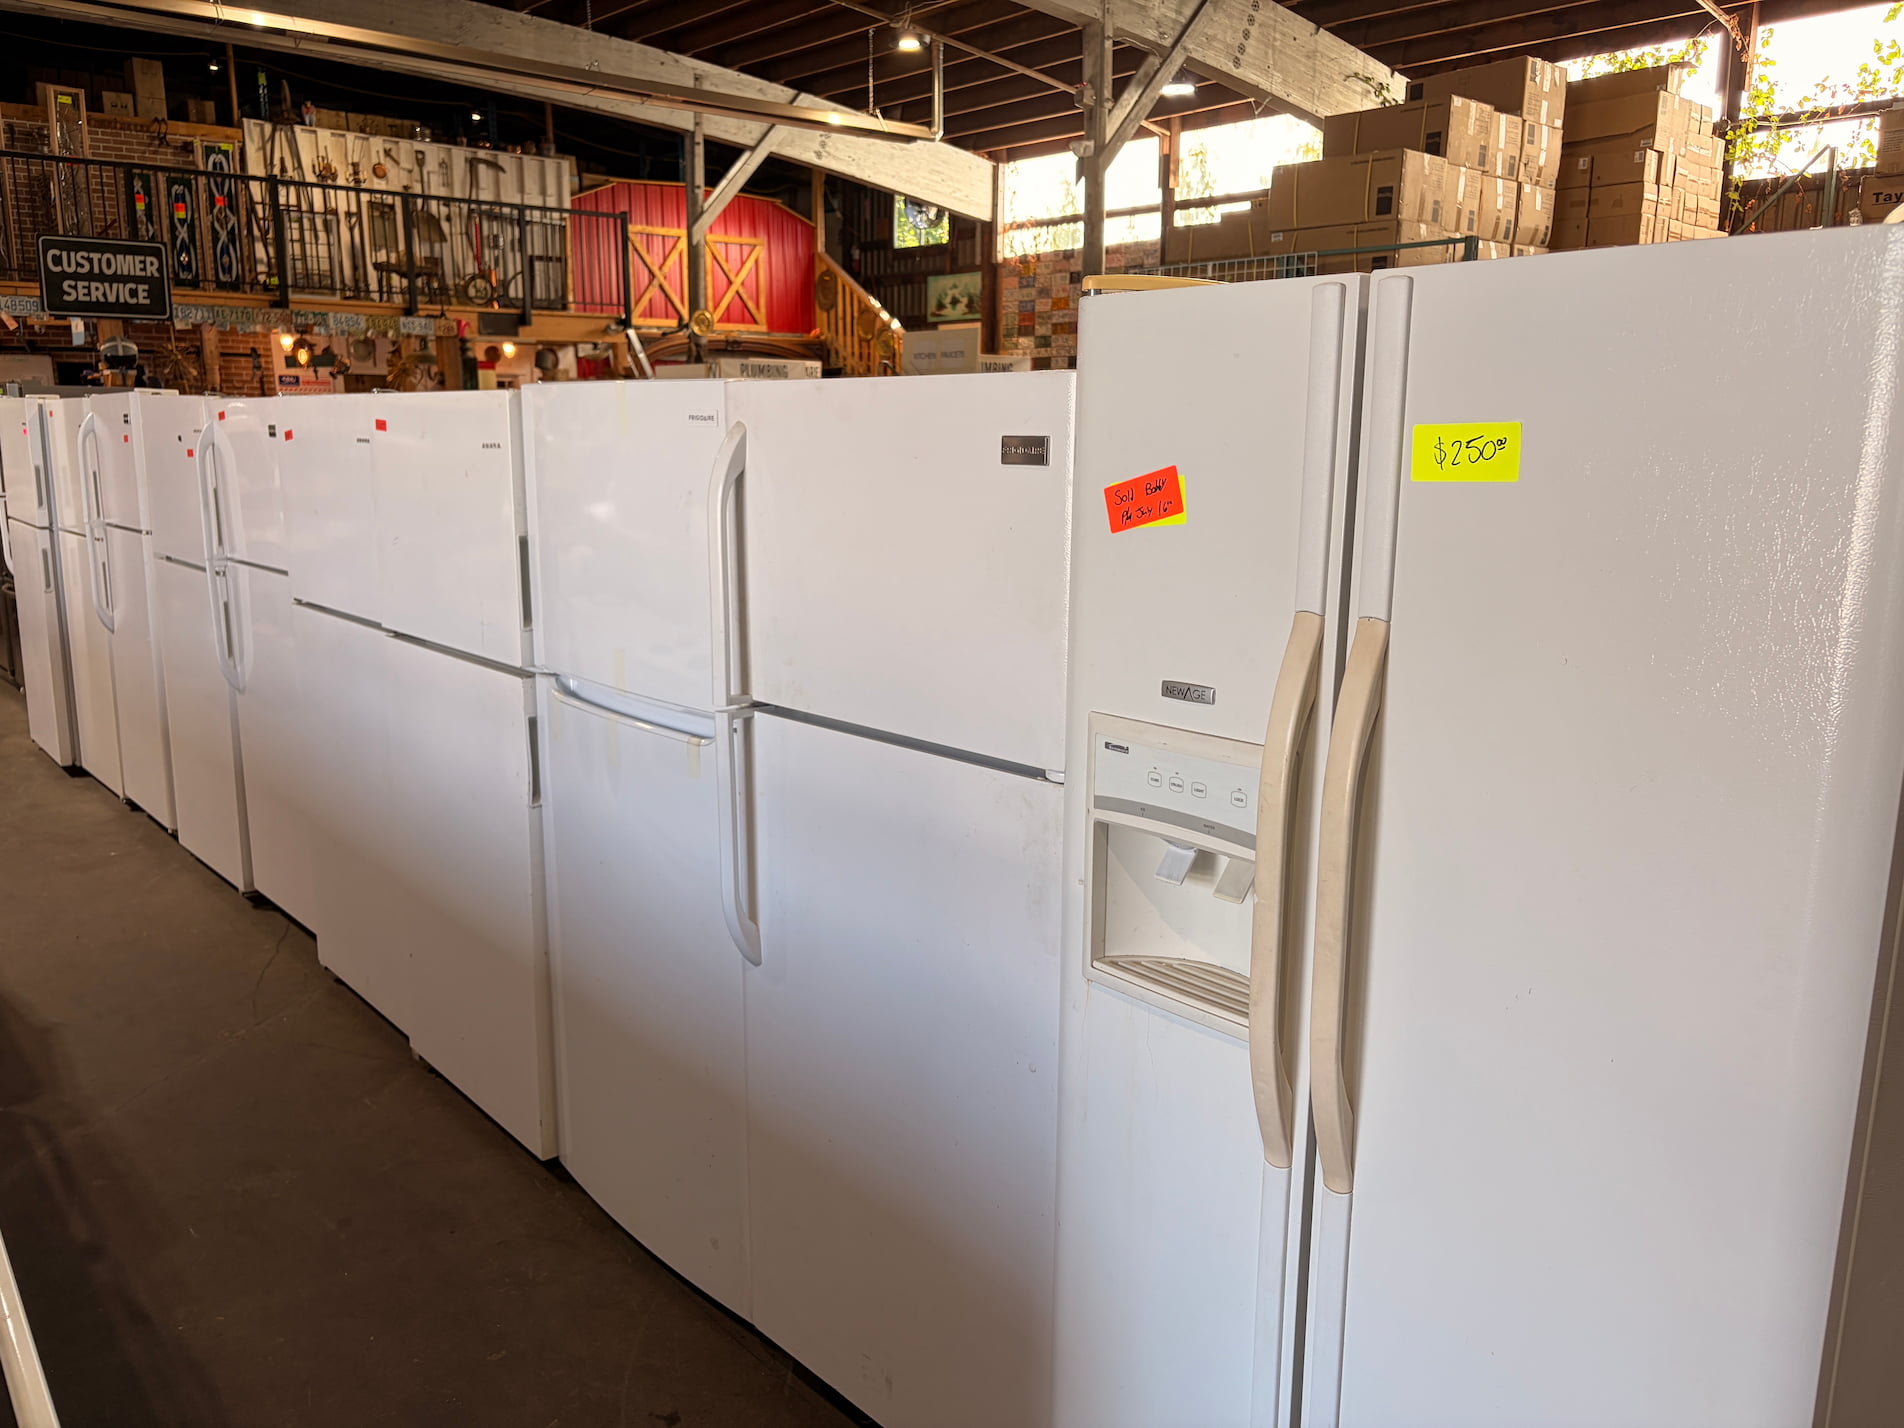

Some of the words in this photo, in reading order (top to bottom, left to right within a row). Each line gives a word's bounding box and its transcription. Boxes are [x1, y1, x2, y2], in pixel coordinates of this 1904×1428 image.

[46, 249, 160, 278] CUSTOMER
[62, 280, 150, 304] SERVICE
[0, 298, 39, 313] 48509
[740, 363, 789, 378] PLUMBING
[1114, 487, 1134, 505] Sold
